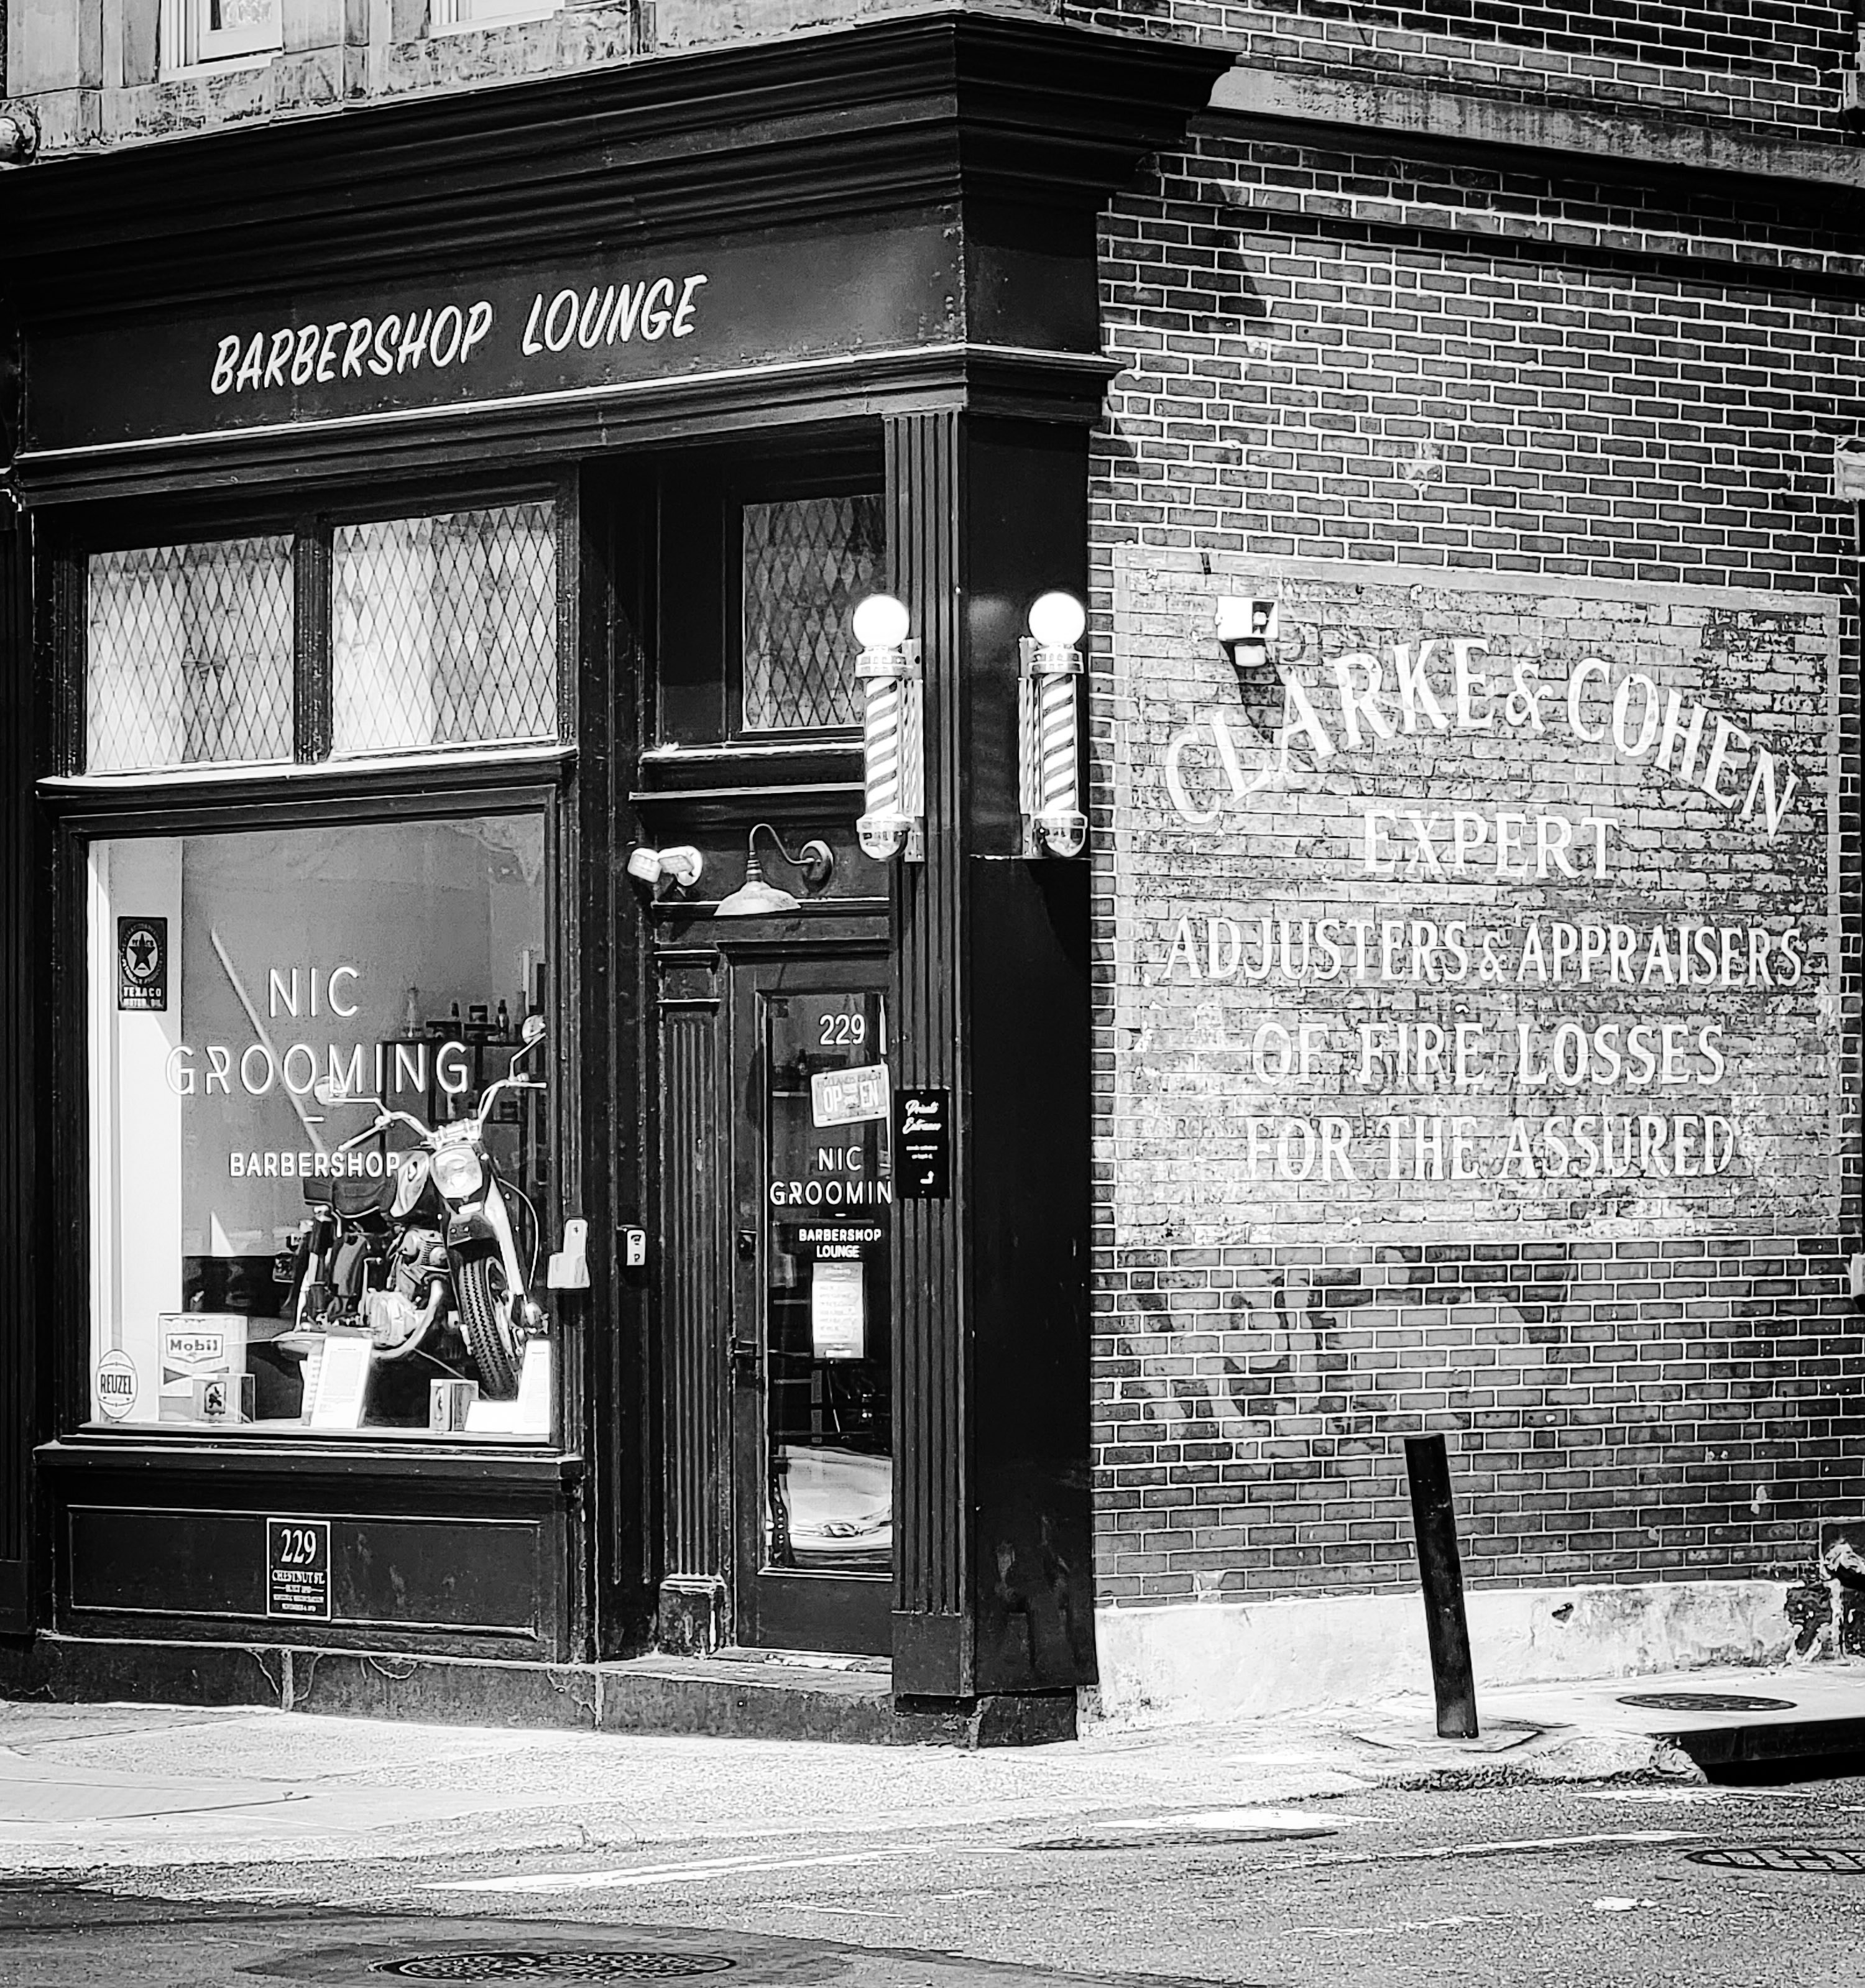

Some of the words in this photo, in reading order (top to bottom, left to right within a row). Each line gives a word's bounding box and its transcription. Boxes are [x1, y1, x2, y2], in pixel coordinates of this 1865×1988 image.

[211, 301, 492, 395] BARBERSHOP
[522, 274, 707, 356] LOUNGE
[1165, 637, 1497, 824] CLARKE
[1506, 660, 1553, 732] &
[1566, 656, 1802, 838] COHEN
[1363, 809, 1619, 881] EXPERT
[1161, 915, 1468, 981] ADJUSTERS
[1480, 929, 1509, 982] &
[1516, 923, 1804, 987] APPRAISERS
[124, 987, 162, 997] TEXACO
[268, 966, 359, 1018] NIC
[820, 1014, 865, 1044] 229
[165, 1042, 469, 1095] GROOMING
[1251, 1021, 1329, 1087] OF
[1357, 1022, 1487, 1087] FIRE
[1517, 1023, 1726, 1087] LOSSES
[819, 1146, 862, 1170] NIC
[1246, 1116, 1359, 1180] FOR
[1380, 1115, 1480, 1180] THE
[1497, 1115, 1736, 1180] ASSURED
[229, 1151, 400, 1178] BARBERSHOP
[770, 1181, 892, 1205] GROOMIN
[799, 1229, 881, 1241] BARBERSHOP
[817, 1245, 859, 1258] LOUNGE
[170, 1339, 217, 1351] Mobil
[100, 1373, 132, 1395] REUZEL
[282, 1529, 316, 1564] 229
[272, 1569, 313, 1583] CHESTNUT
